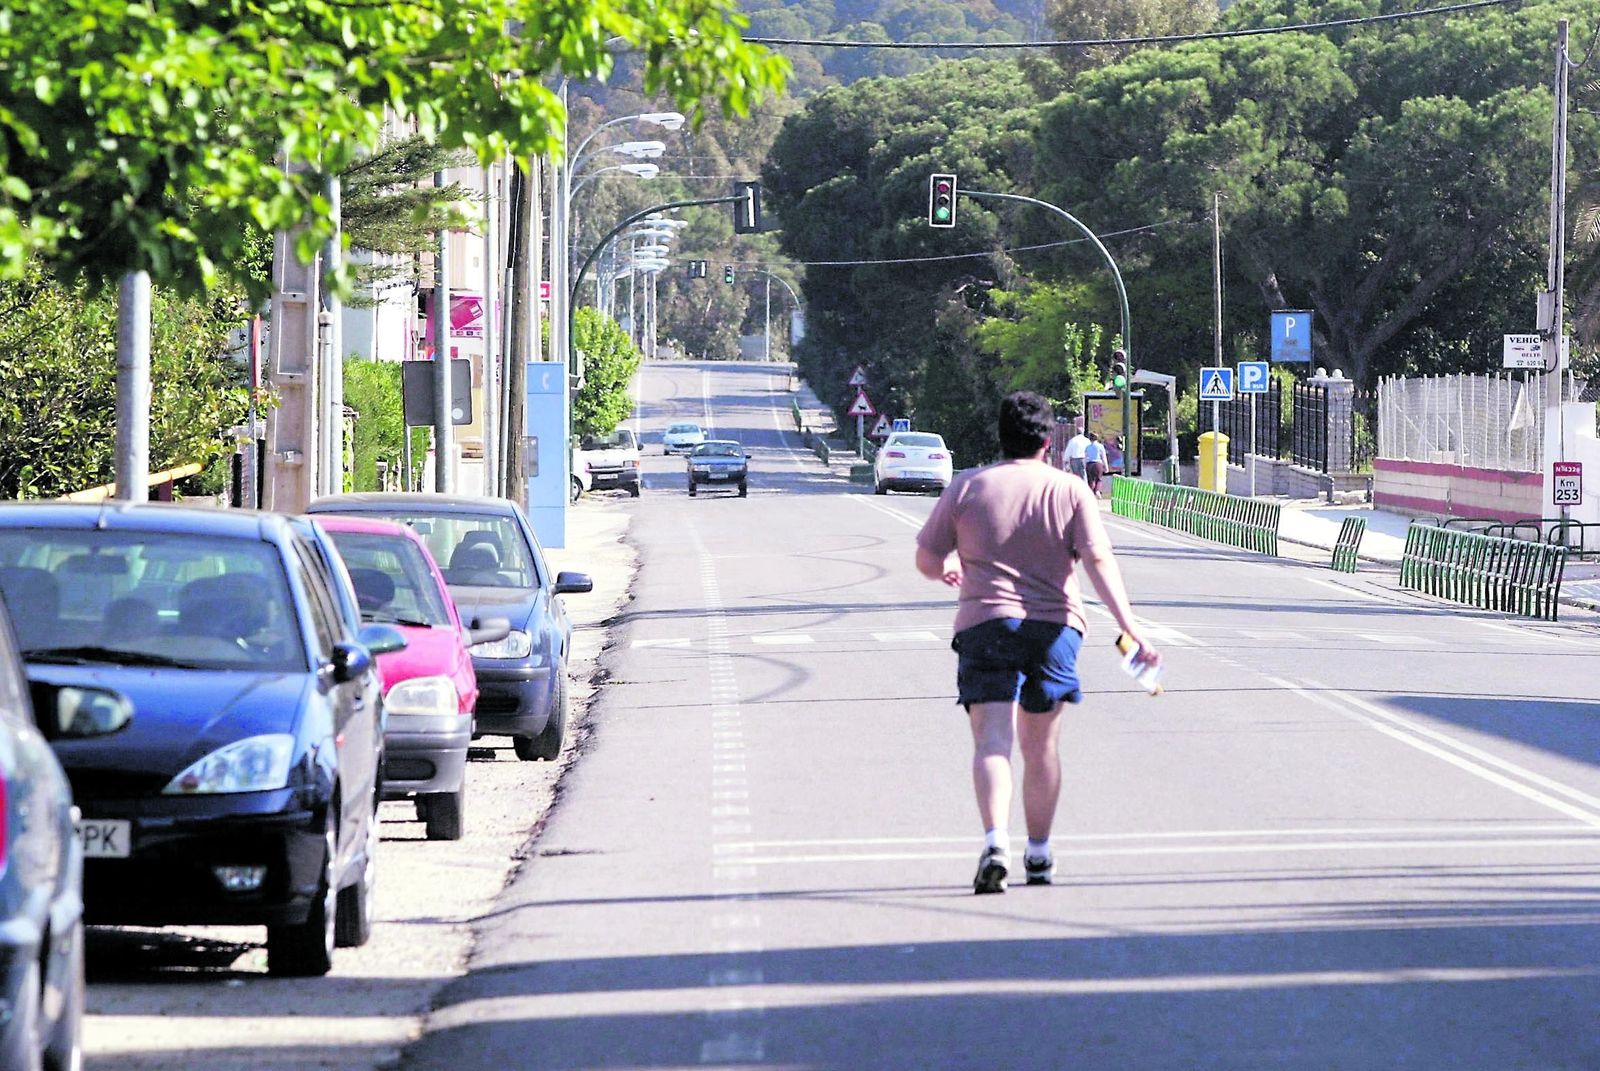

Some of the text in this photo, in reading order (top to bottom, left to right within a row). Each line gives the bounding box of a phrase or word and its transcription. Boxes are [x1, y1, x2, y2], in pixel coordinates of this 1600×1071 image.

[1285, 316, 1296, 338] P
[1244, 365, 1262, 388] P
[1560, 478, 1575, 487] Km
[1556, 489, 1579, 501] 253
[77, 825, 117, 851] PK
